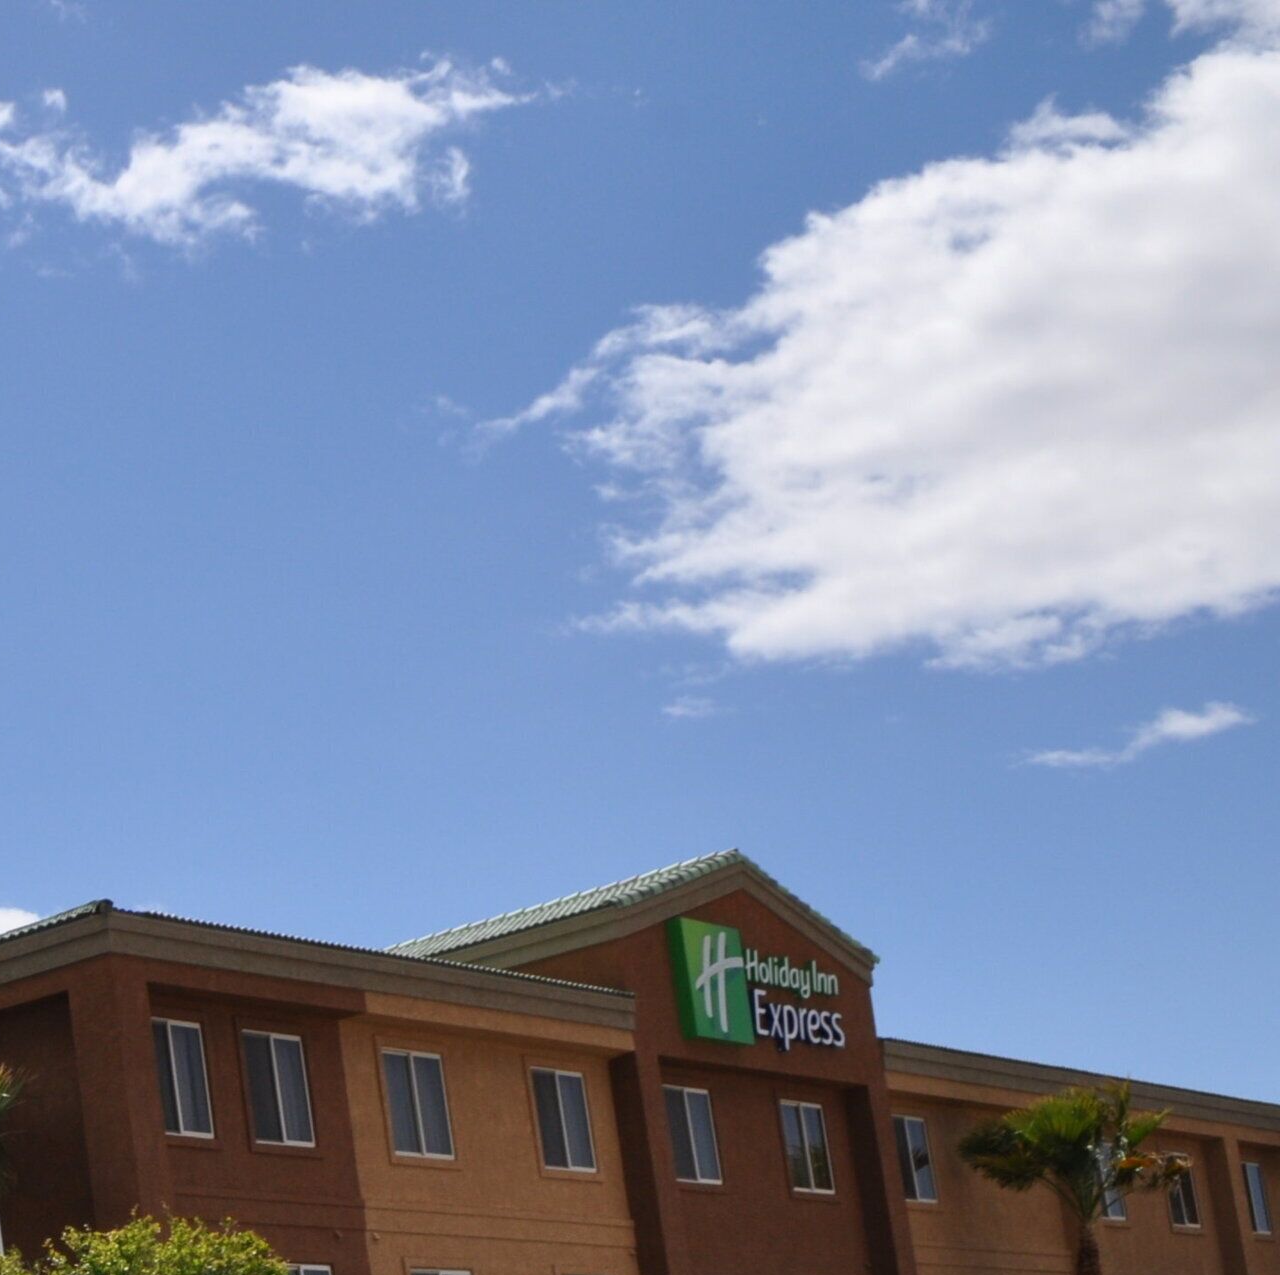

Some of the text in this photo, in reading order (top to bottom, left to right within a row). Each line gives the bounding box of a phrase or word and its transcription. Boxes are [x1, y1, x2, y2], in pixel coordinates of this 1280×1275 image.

[746, 949, 839, 999] Holiday Inn
[753, 989, 846, 1051] Express
